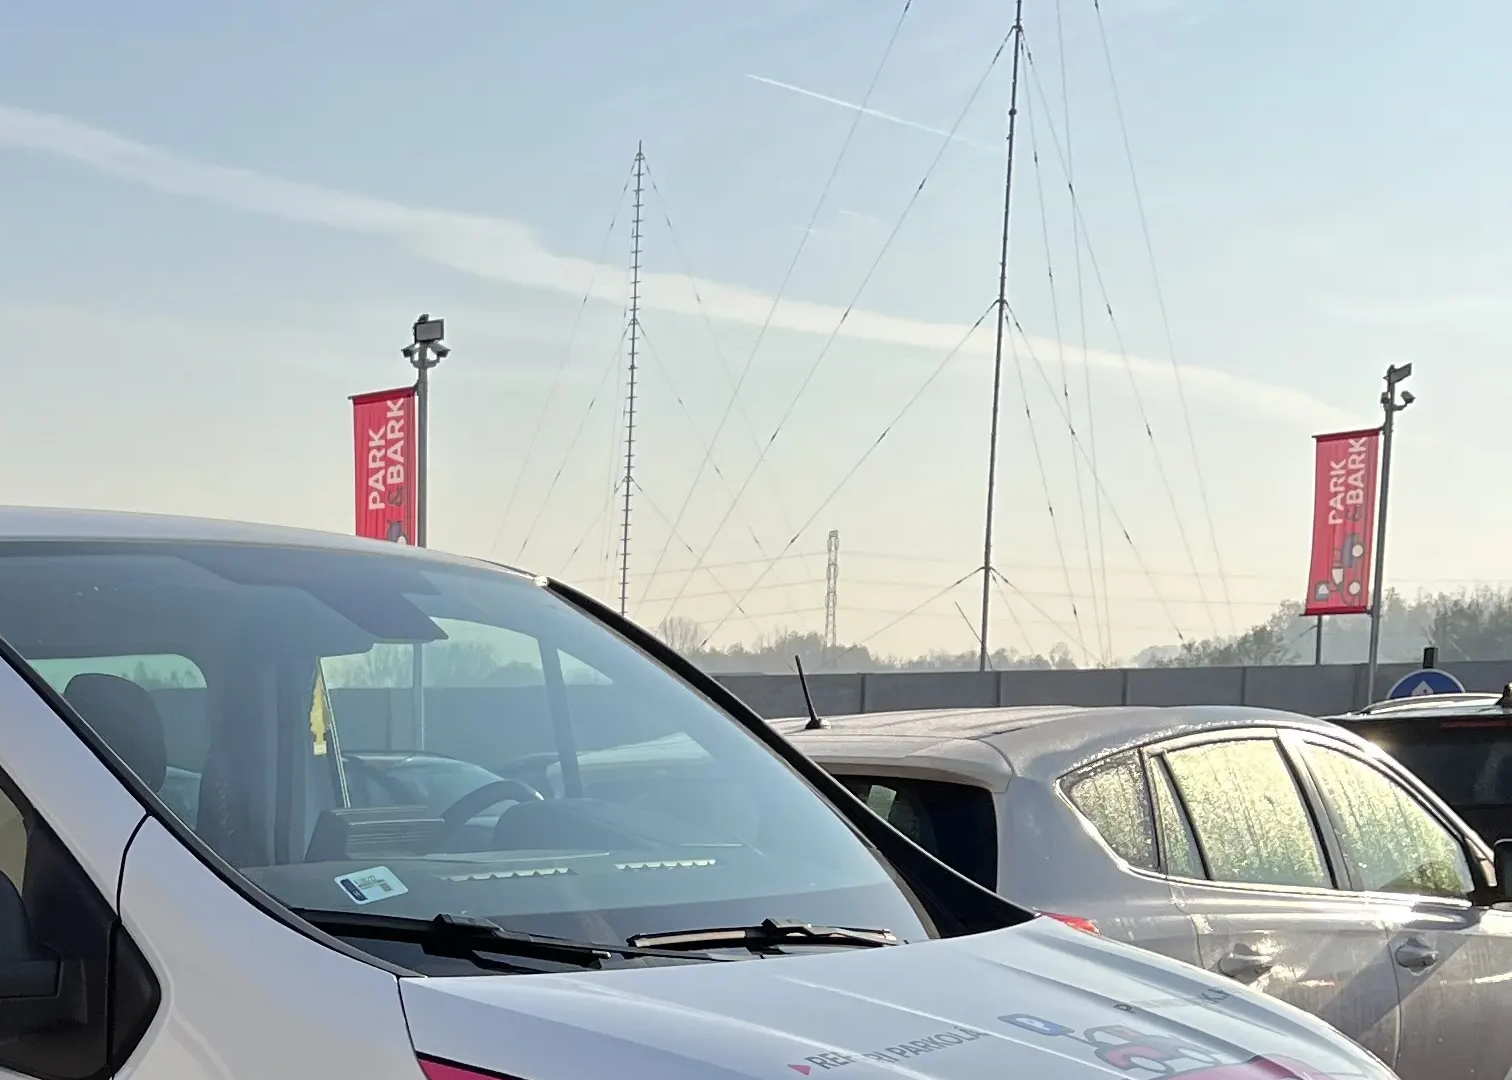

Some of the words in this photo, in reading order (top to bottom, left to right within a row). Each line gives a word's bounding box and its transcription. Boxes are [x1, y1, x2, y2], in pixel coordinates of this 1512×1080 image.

[368, 425, 386, 510] PARK
[386, 397, 405, 485] BARK
[1346, 437, 1368, 505] BARK
[1327, 459, 1346, 525] PARK
[804, 1050, 901, 1070] REPRI
[884, 1025, 991, 1059] PARKOLÁ
